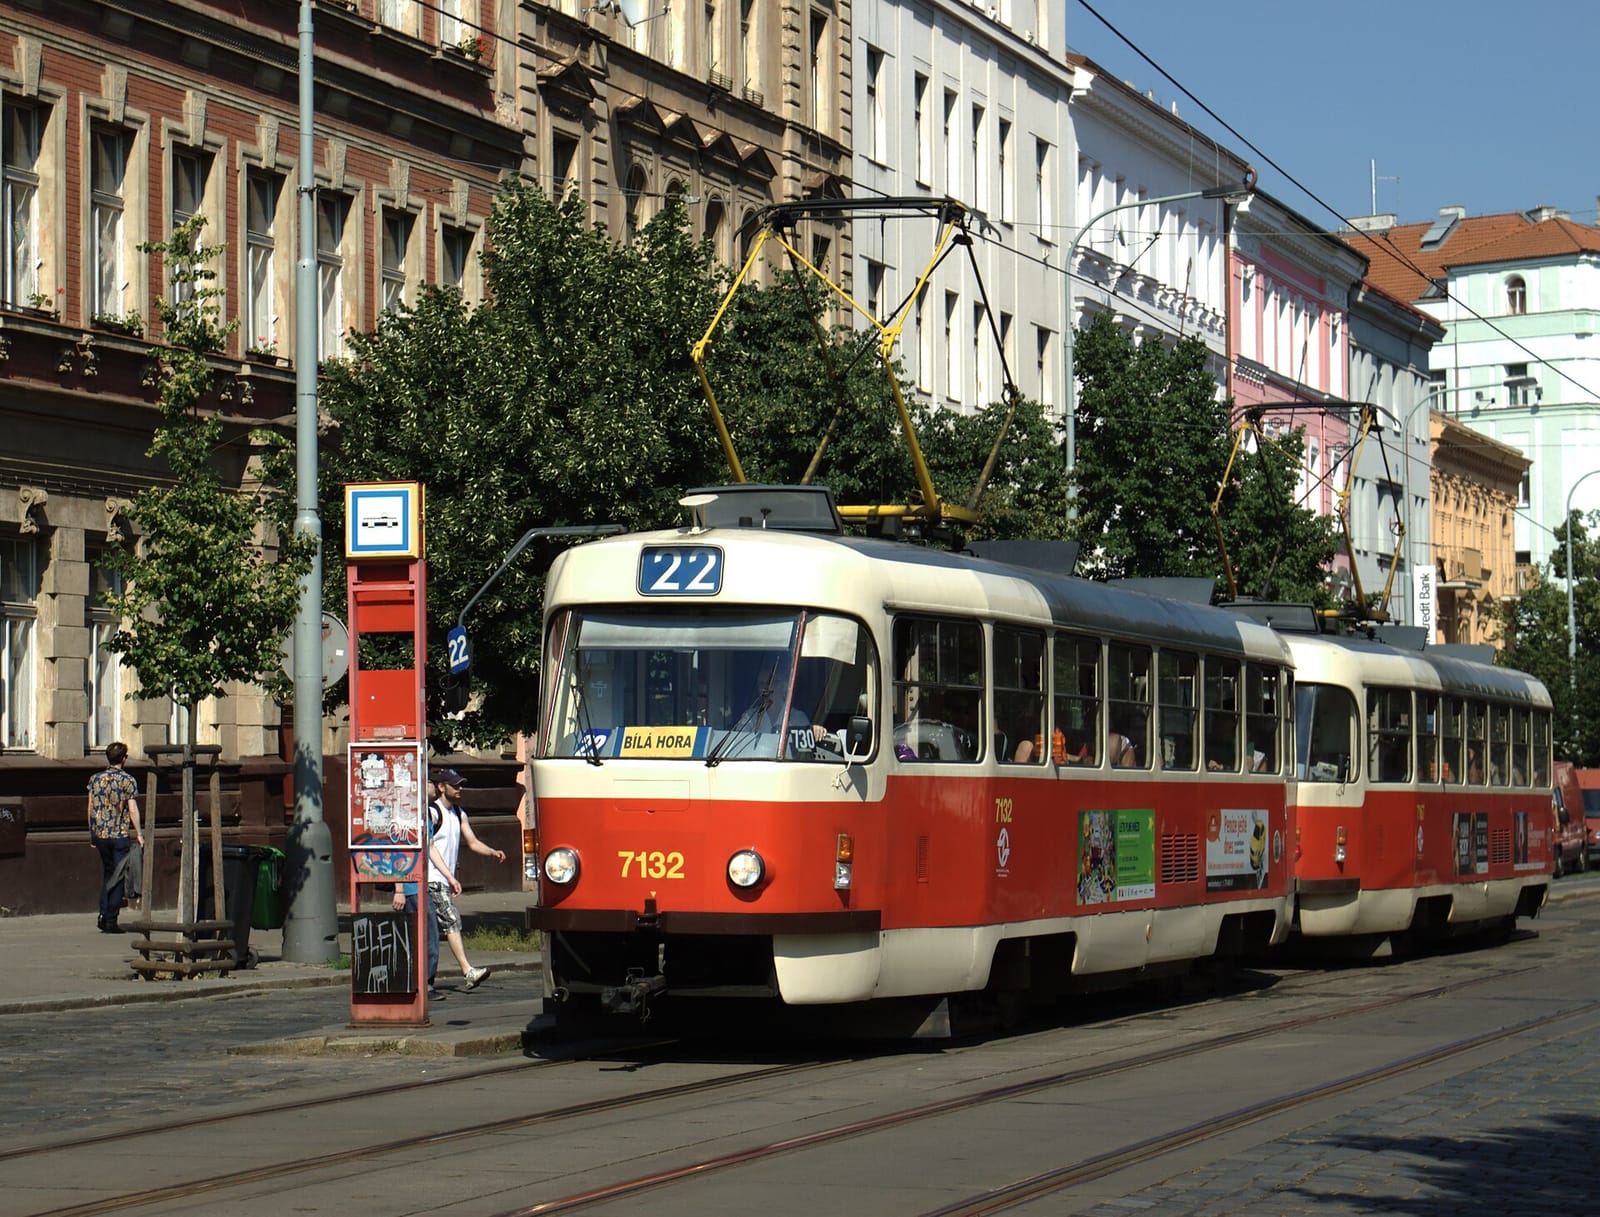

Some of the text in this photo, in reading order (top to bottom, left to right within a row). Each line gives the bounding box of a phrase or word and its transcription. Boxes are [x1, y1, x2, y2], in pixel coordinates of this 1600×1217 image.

[650, 548, 717, 591] 22
[1419, 572, 1431, 600] Bank
[448, 634, 469, 668] 22
[623, 732, 692, 749] BÍLÁ HORA
[790, 729, 815, 749] 730
[995, 798, 1013, 823] 7132
[618, 851, 685, 879] 7132
